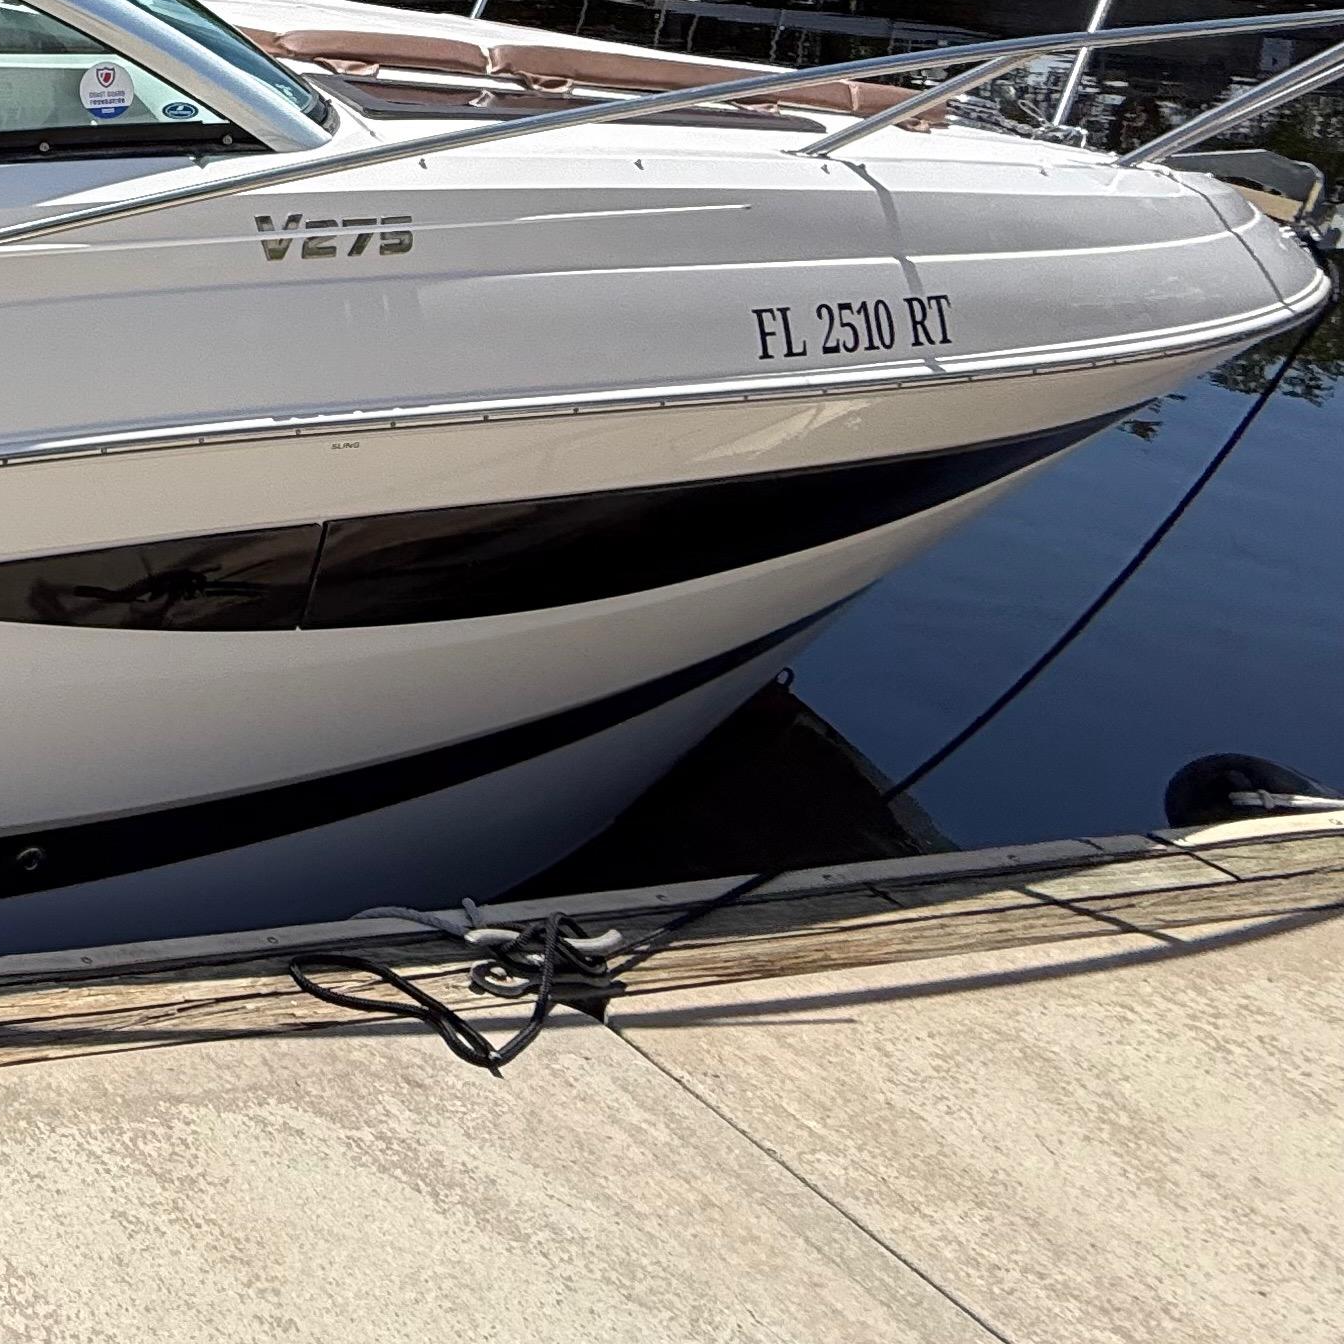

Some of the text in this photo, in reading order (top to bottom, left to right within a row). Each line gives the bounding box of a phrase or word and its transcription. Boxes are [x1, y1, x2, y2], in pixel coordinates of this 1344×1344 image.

[254, 213, 413, 262] V275
[751, 294, 952, 360] FL 2510 RT
